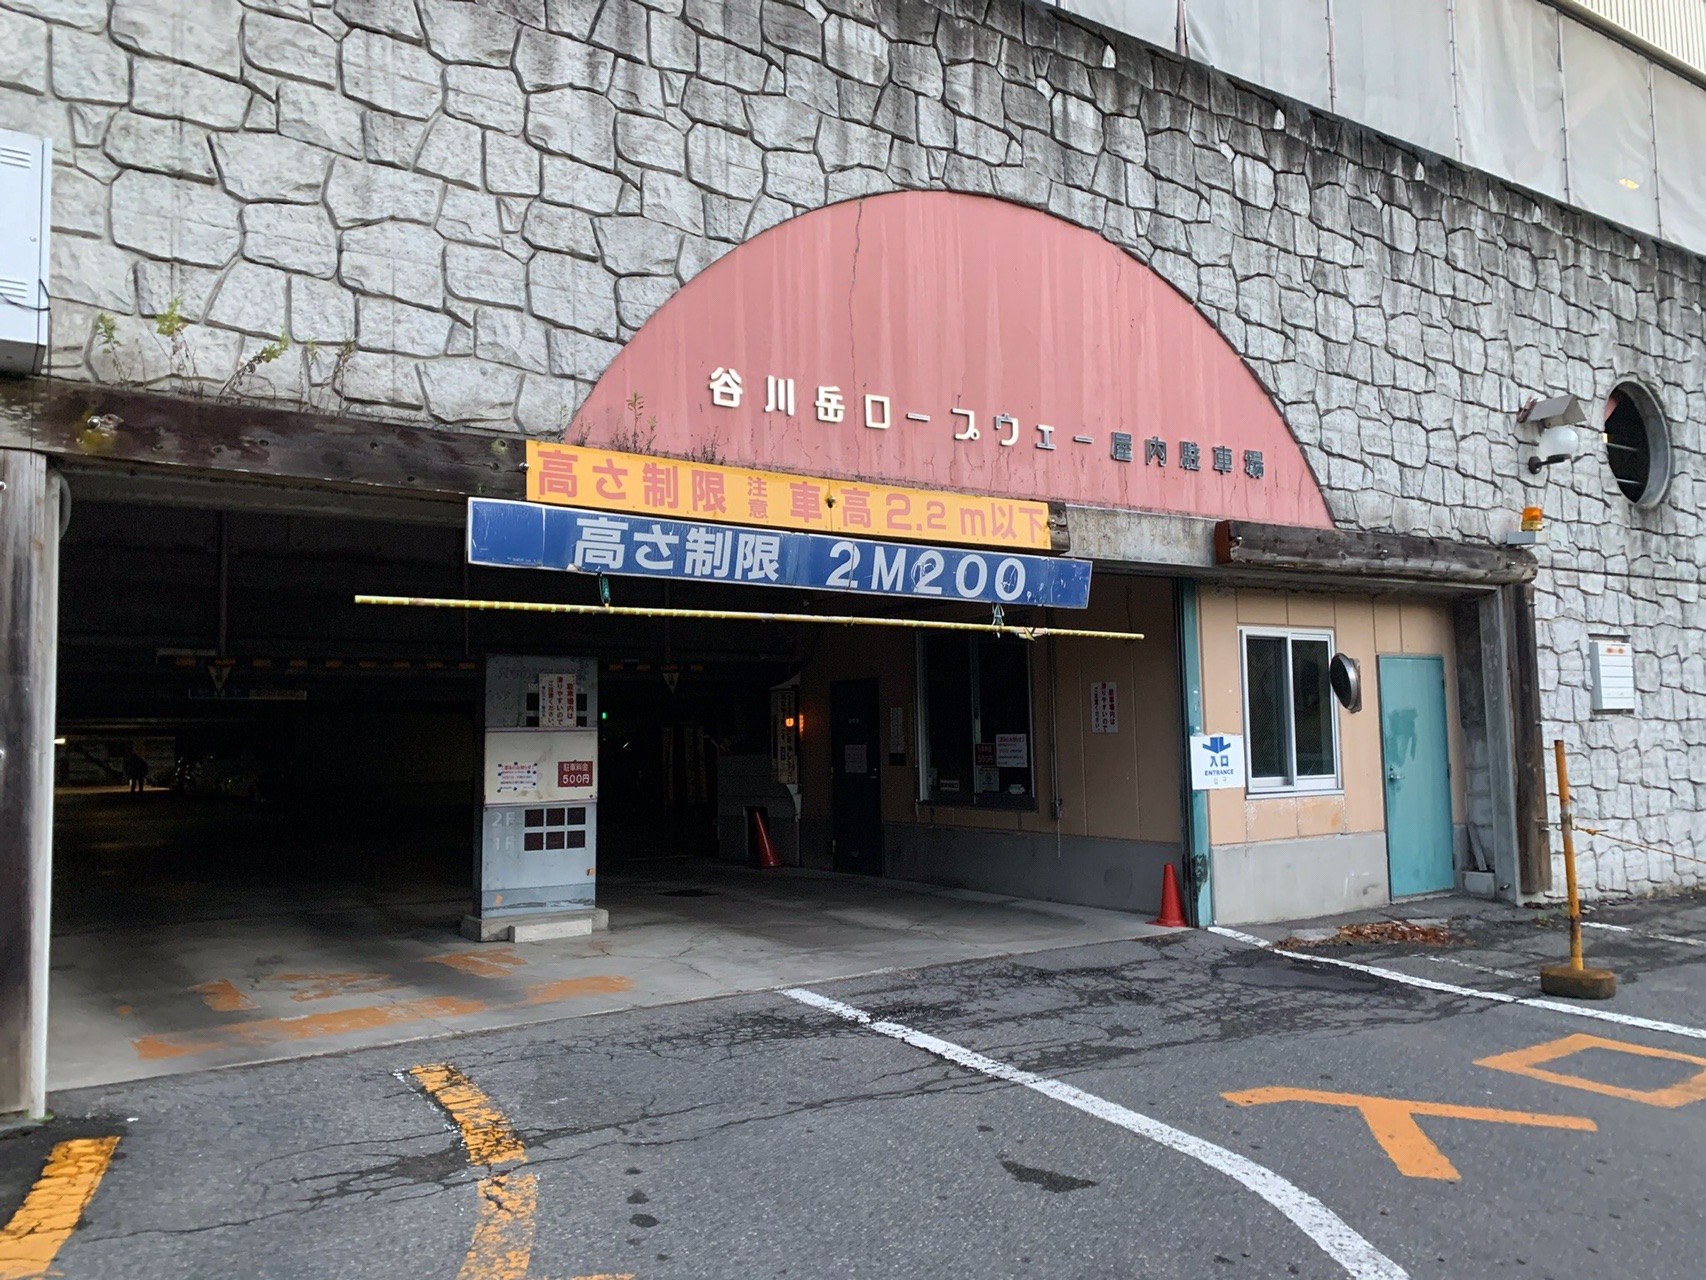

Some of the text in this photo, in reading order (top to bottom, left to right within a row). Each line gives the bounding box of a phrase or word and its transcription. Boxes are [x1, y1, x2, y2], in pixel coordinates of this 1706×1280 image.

[536, 450, 727, 514] 高さ制限
[747, 476, 769, 520] 注意
[573, 517, 780, 583] 高さ制限
[563, 762, 589, 773] 駐車料金
[1209, 754, 1229, 768] 入口
[562, 773, 590, 785] 500円
[491, 811, 516, 828] 2F
[493, 835, 515, 852] 1F
